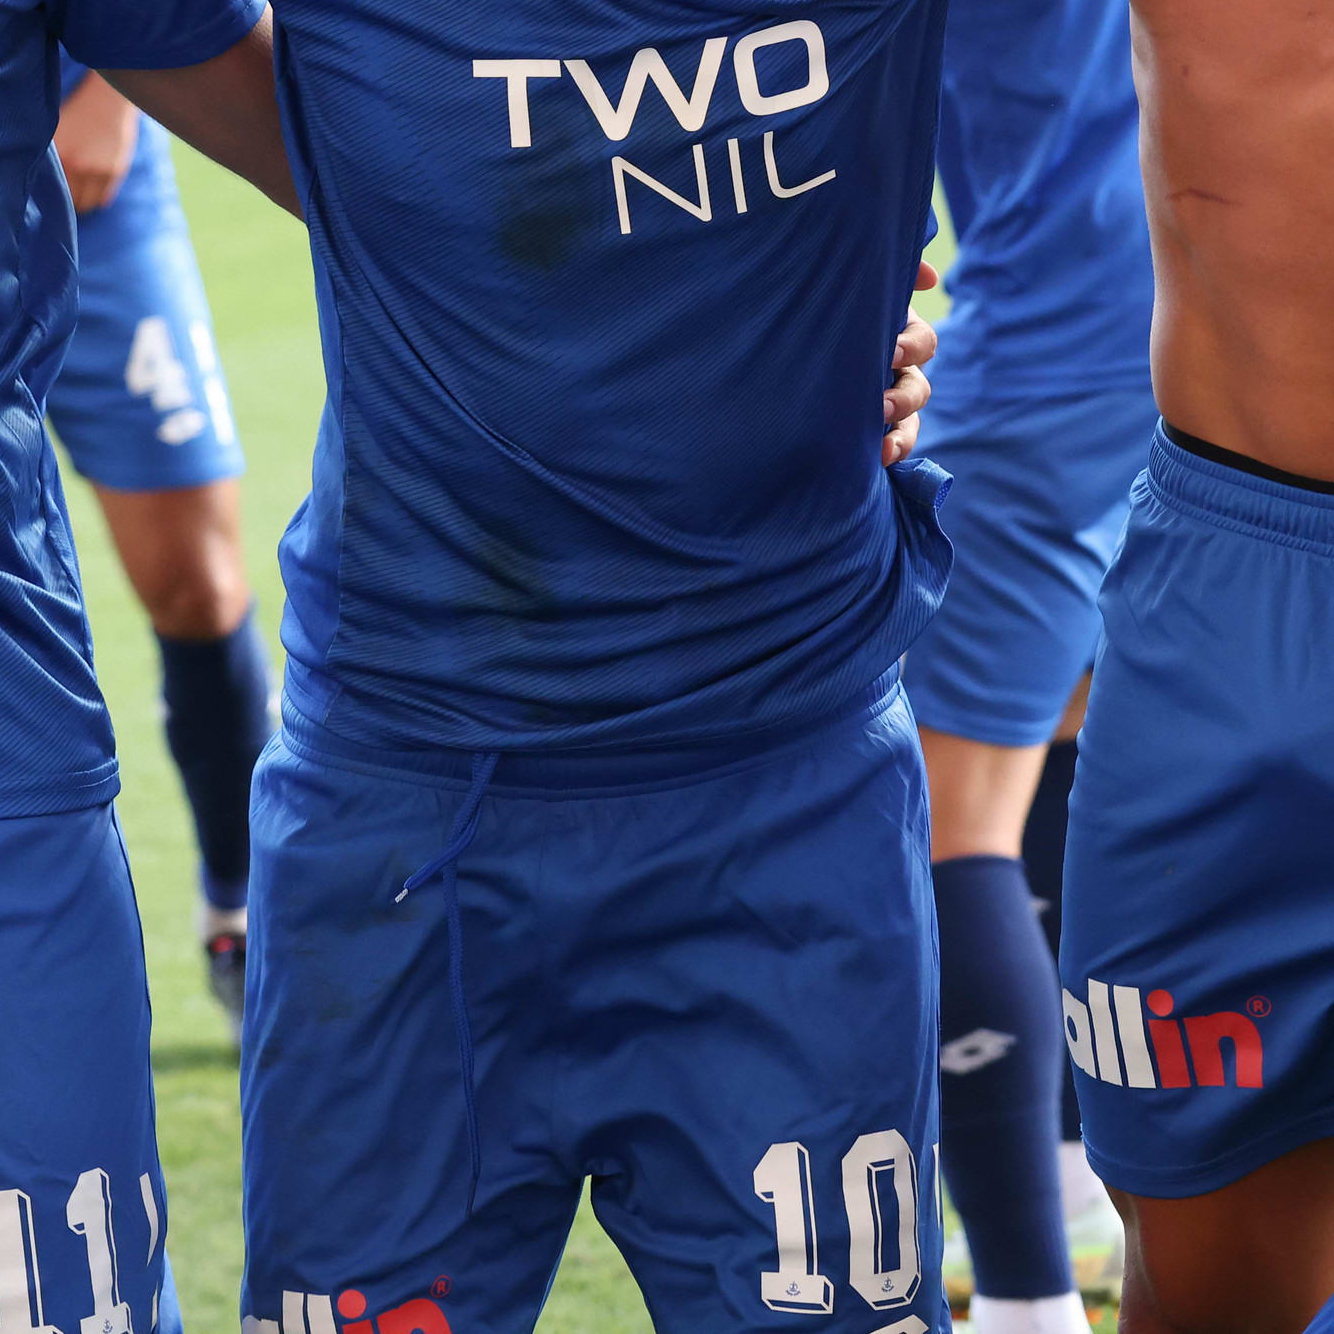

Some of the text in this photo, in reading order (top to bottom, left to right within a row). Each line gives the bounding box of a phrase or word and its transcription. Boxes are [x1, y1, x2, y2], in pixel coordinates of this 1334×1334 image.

[472, 19, 831, 148] TWO
[611, 131, 837, 235] NIL
[124, 315, 192, 413] 4
[753, 1128, 922, 1314] 10
